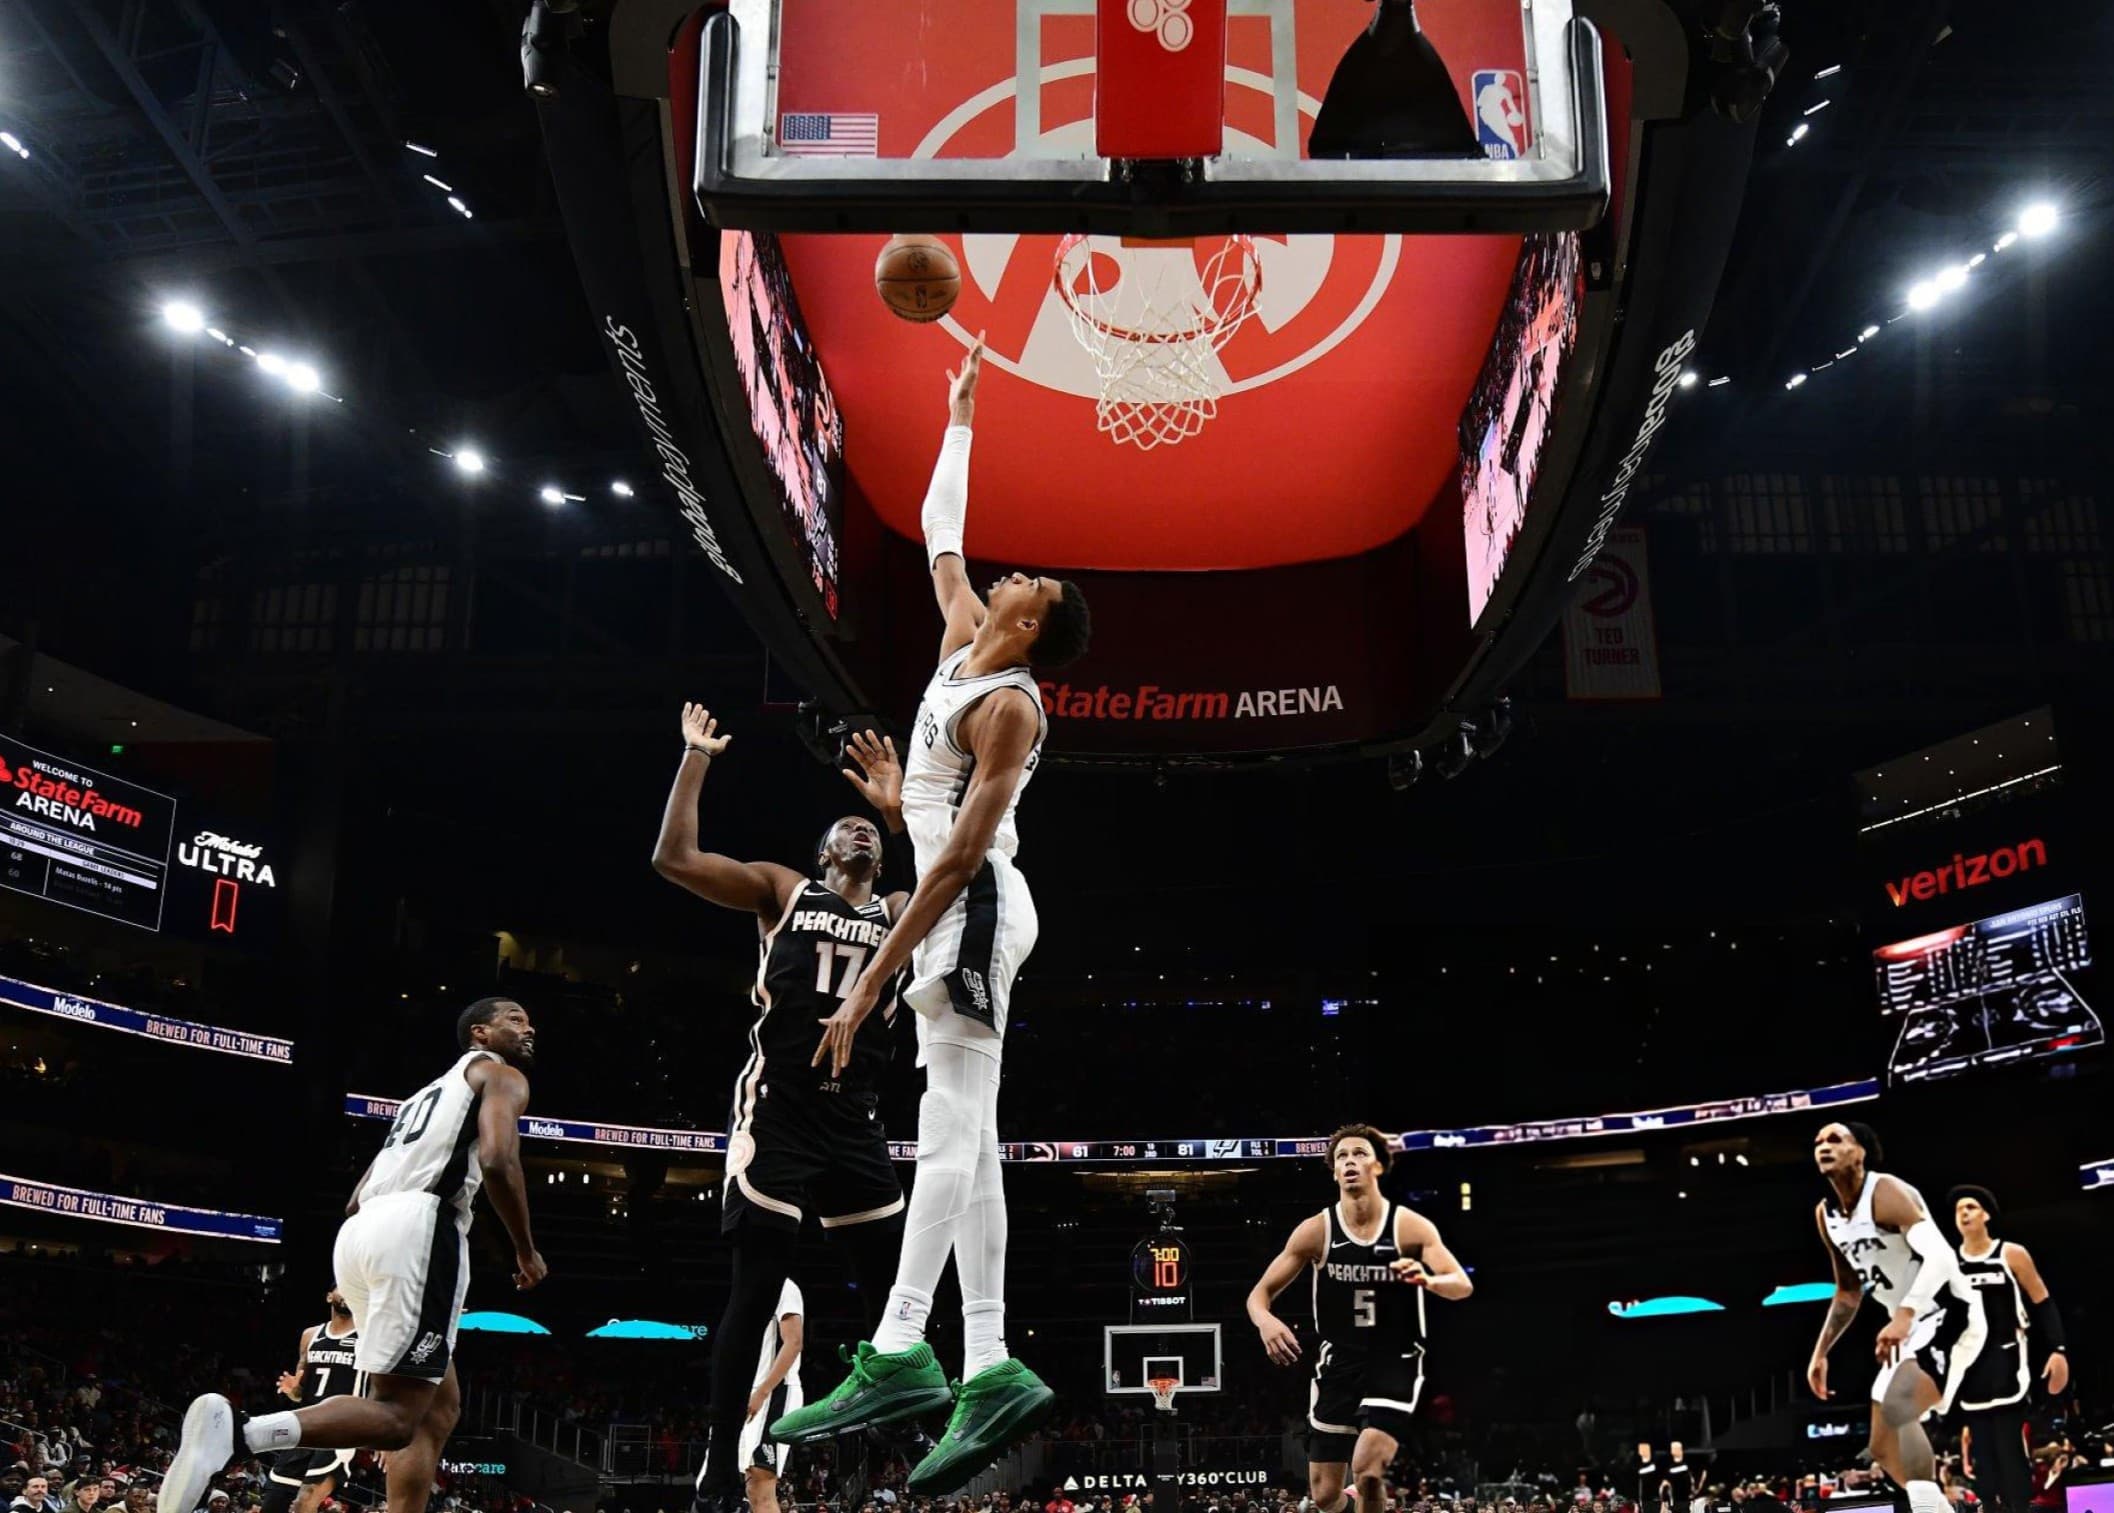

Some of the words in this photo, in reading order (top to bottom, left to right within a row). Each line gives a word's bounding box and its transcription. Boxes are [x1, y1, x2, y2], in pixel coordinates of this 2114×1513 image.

[1484, 143, 1509, 159] NBA
[1583, 648, 1640, 666] TURNER
[1235, 685, 1344, 718] ARENA
[32, 760, 79, 783] WELCOME
[81, 777, 93, 787] TO
[16, 791, 96, 831] ARENA
[10, 822, 46, 841] AROUND
[47, 833, 64, 846] THE
[64, 837, 96, 856] LEAGUE
[178, 843, 276, 887] ULTRA
[1886, 838, 2047, 907] verizon
[816, 941, 868, 999] 17
[53, 997, 95, 1019] Modelo
[146, 1019, 187, 1040] BREWED
[190, 1028, 209, 1045] FOR
[212, 1033, 263, 1054] FULL-TIME
[266, 1043, 290, 1059] FANS
[367, 1102, 399, 1117] BREWE
[529, 1121, 564, 1137] Modelo
[595, 1128, 629, 1142] BREWED
[631, 1131, 648, 1144] FOR
[650, 1133, 692, 1147] FULL-TIME
[695, 1136, 715, 1148] FANS
[902, 1145, 918, 1157] FAN
[1113, 1145, 1136, 1157] 7:00
[1178, 1144, 1193, 1156] 81
[12, 1184, 55, 1207] BREWED
[57, 1193, 78, 1211] FOR
[81, 1198, 136, 1220] FULL-TIME
[138, 1207, 165, 1225] FANS
[1150, 1248, 1179, 1262] 7:00
[1155, 1262, 1177, 1287] 10
[1151, 1297, 1186, 1305] TISSOT
[1354, 1290, 1376, 1327] 5
[314, 1368, 331, 1397] 7
[1084, 1474, 1147, 1488] DELTA
